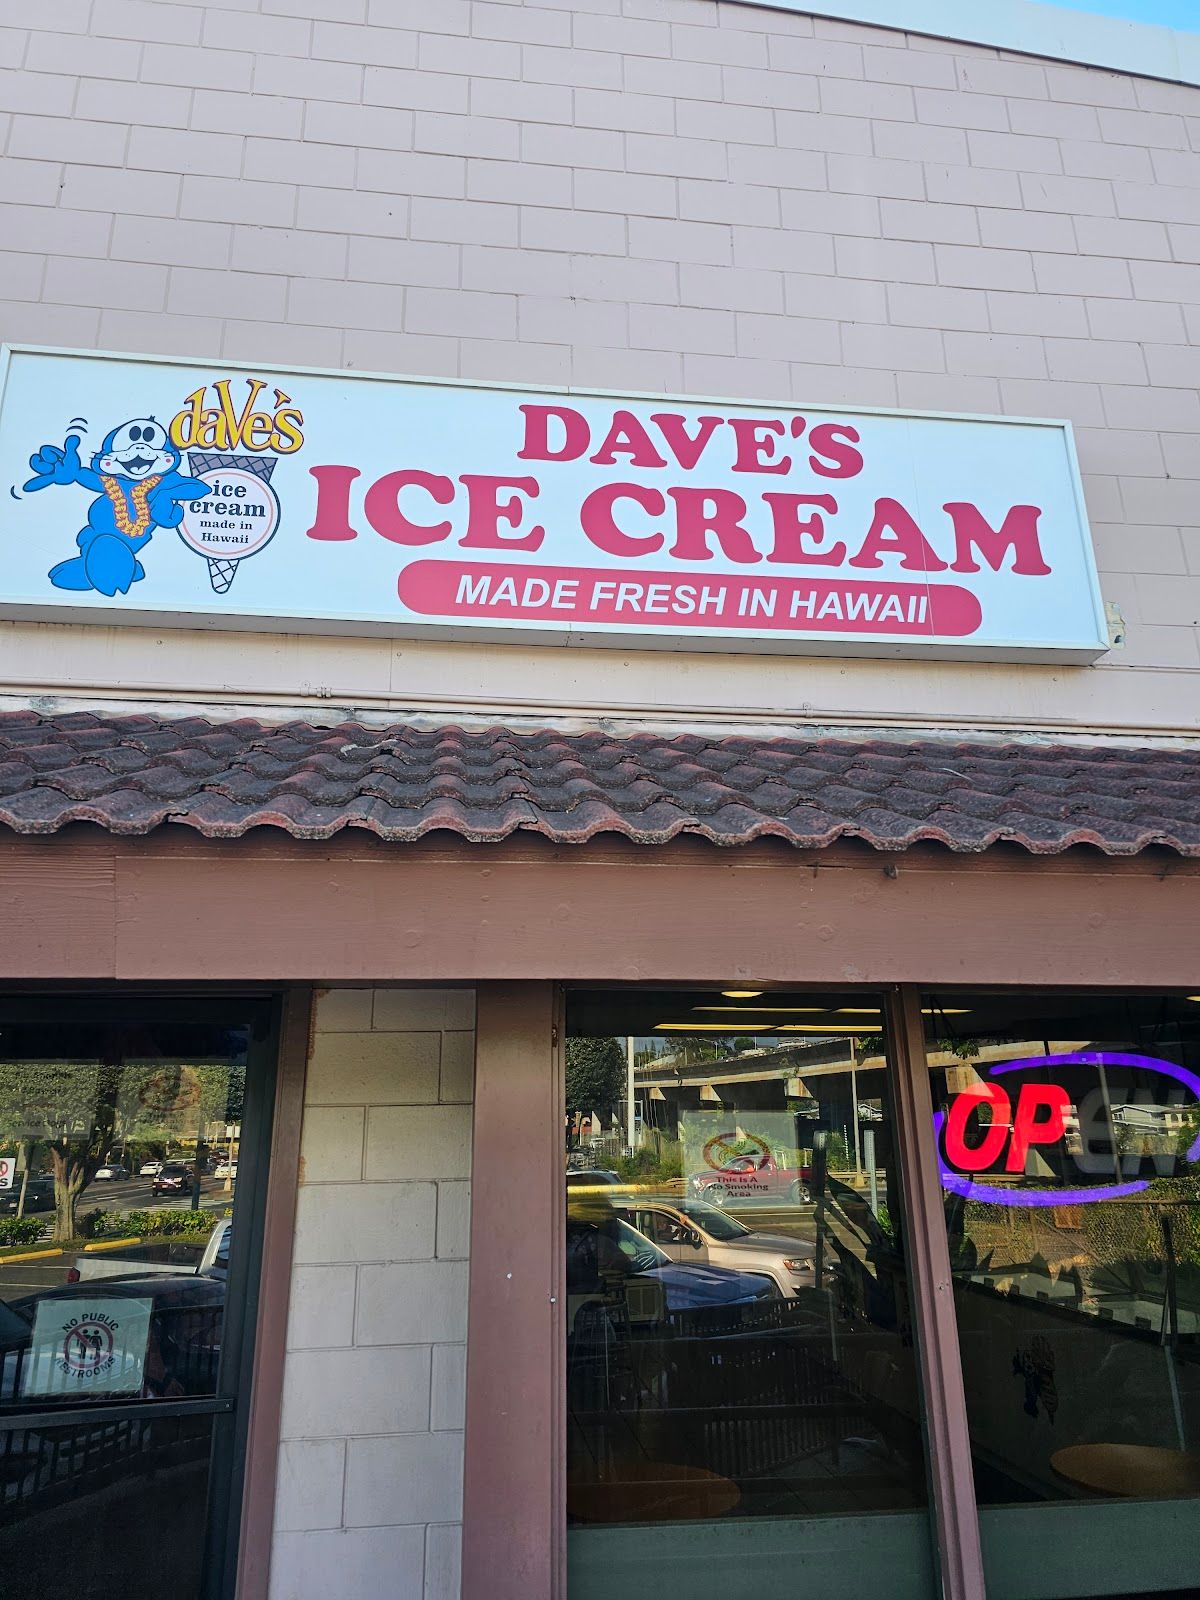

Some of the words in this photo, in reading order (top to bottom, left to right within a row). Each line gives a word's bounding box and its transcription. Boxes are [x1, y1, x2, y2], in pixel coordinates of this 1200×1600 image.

[517, 404, 864, 479] DAVE'S
[212, 479, 247, 498] ice
[189, 500, 266, 518] cream
[200, 520, 236, 529] made
[239, 521, 253, 530] in
[307, 465, 545, 552] ICE
[580, 482, 1052, 576] CREAM
[201, 532, 249, 544] Hawaii
[454, 574, 579, 610] MADE
[589, 581, 728, 616] FRESH
[737, 587, 778, 618] IN
[789, 589, 928, 624] HAWAII
[725, 1183, 769, 1191] Smoking
[62, 1318, 78, 1333] NO
[81, 1312, 120, 1332] PUBLIC
